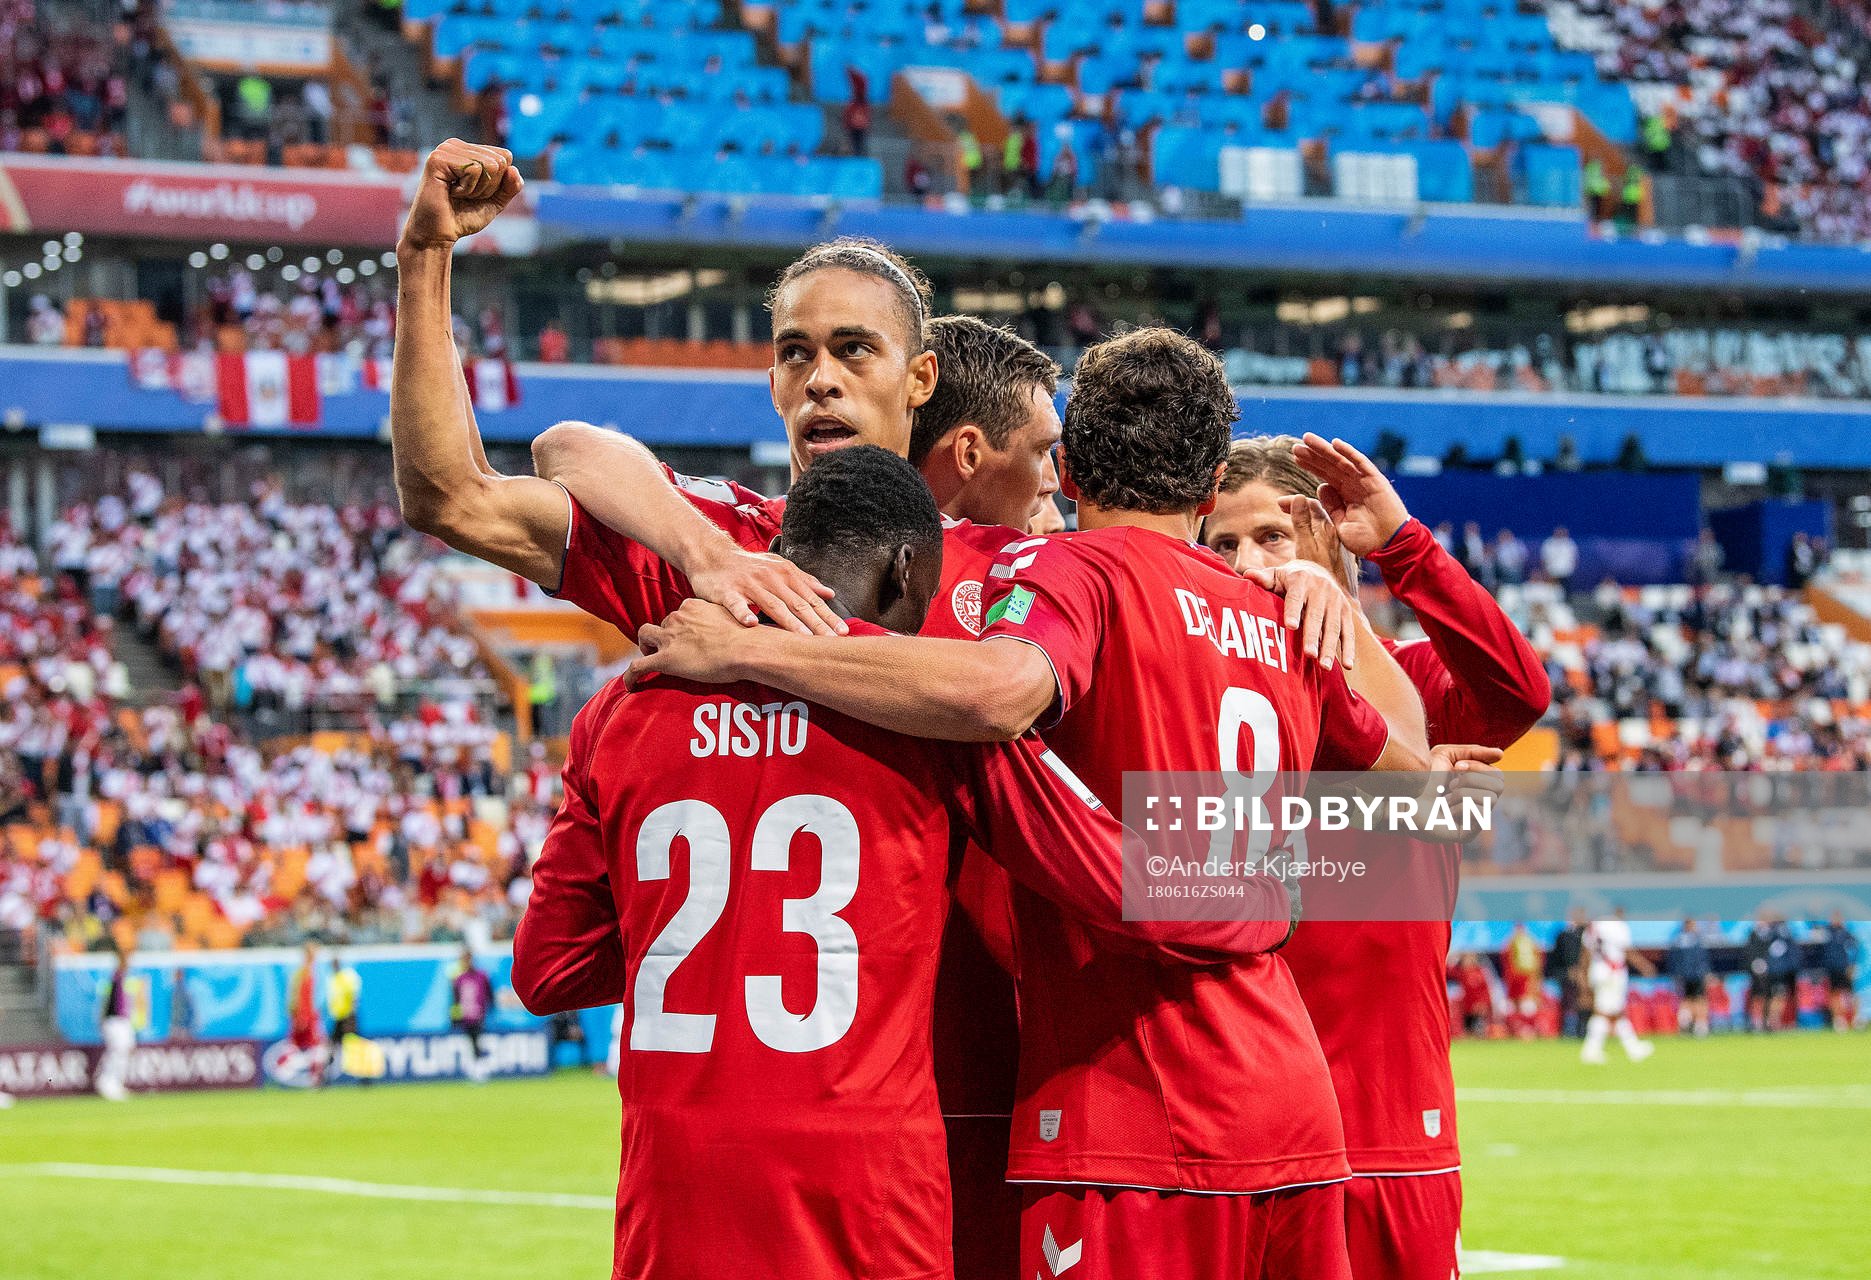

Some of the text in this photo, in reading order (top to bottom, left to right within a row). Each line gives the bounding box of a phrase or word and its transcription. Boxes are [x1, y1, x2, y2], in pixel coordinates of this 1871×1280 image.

[1174, 588, 1288, 673] DELANEY
[690, 701, 809, 757] SISTO
[1206, 686, 1280, 877] 8
[630, 794, 861, 1053] 23
[0, 1049, 89, 1091] ATAR
